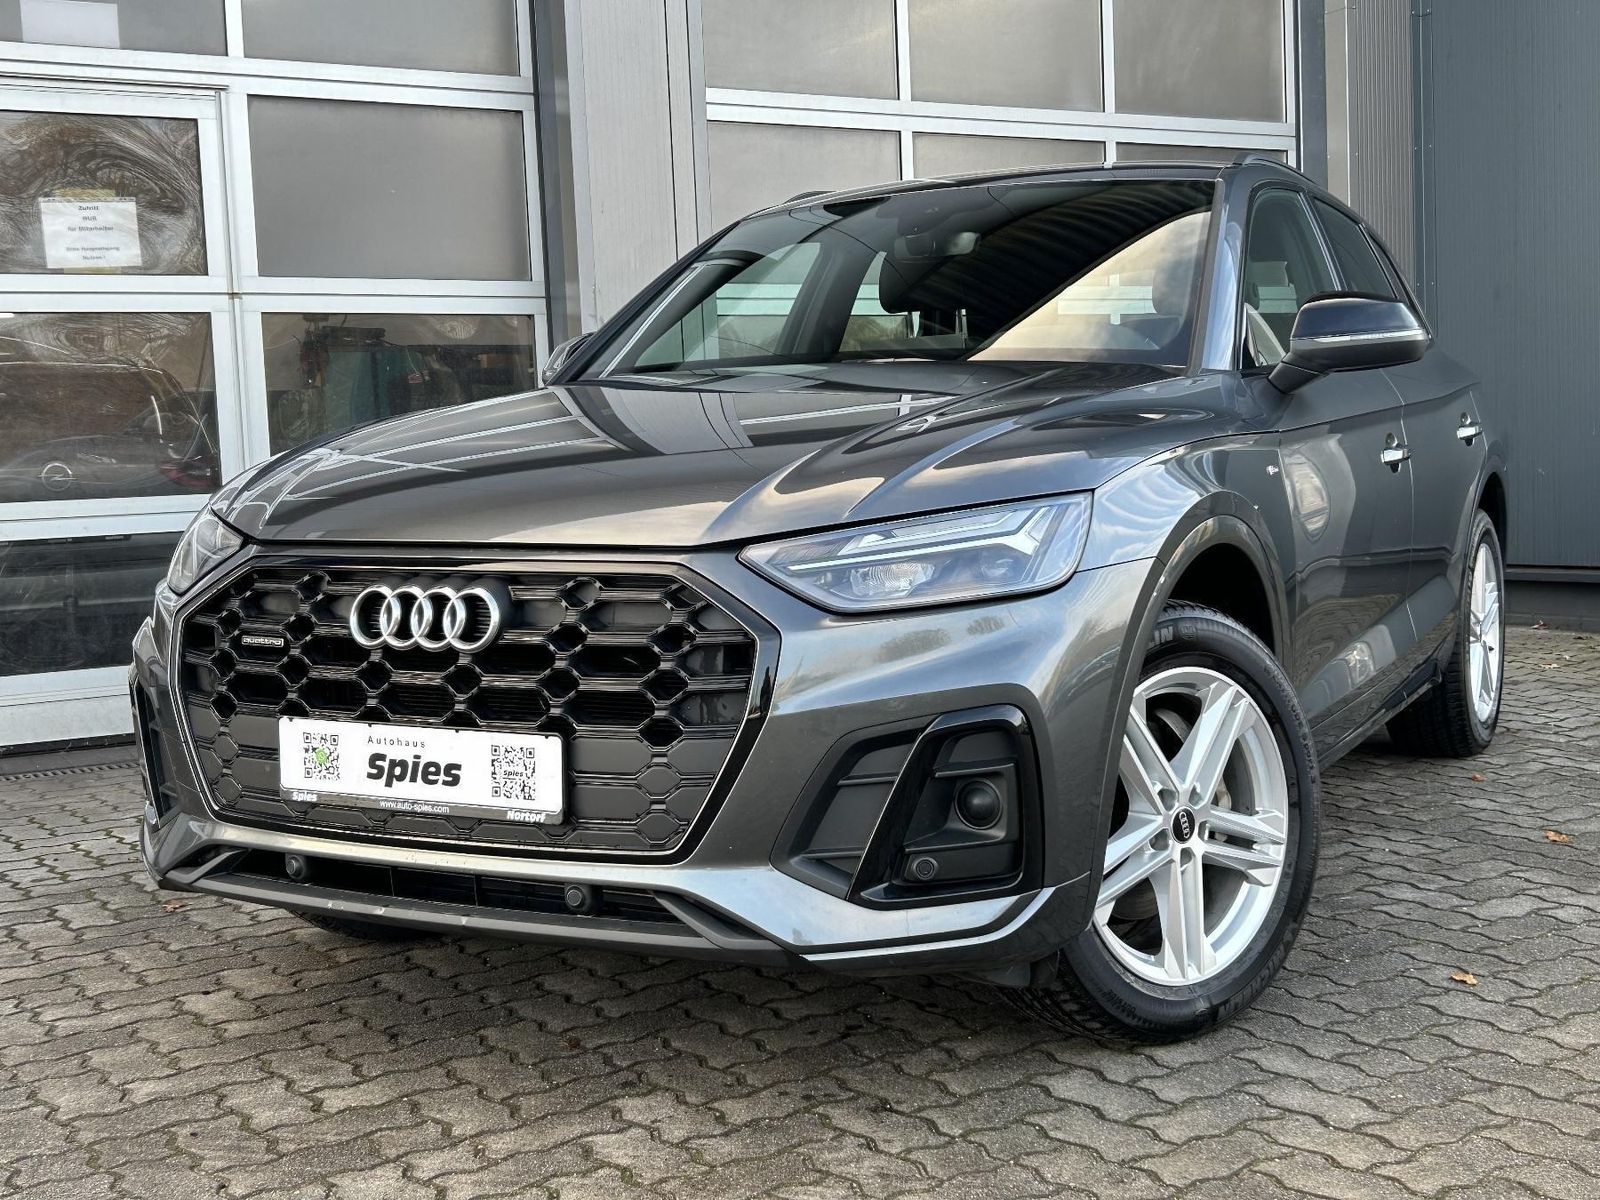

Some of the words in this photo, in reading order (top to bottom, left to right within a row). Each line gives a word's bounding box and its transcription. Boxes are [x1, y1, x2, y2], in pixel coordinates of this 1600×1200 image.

[243, 637, 282, 646] quattro
[367, 735, 426, 748] Autohaus
[366, 752, 462, 788] Spies
[503, 769, 524, 777] Spies
[292, 790, 318, 801] Spies
[379, 800, 450, 814] www.auto-spies.com
[507, 810, 546, 823] Nortorf
